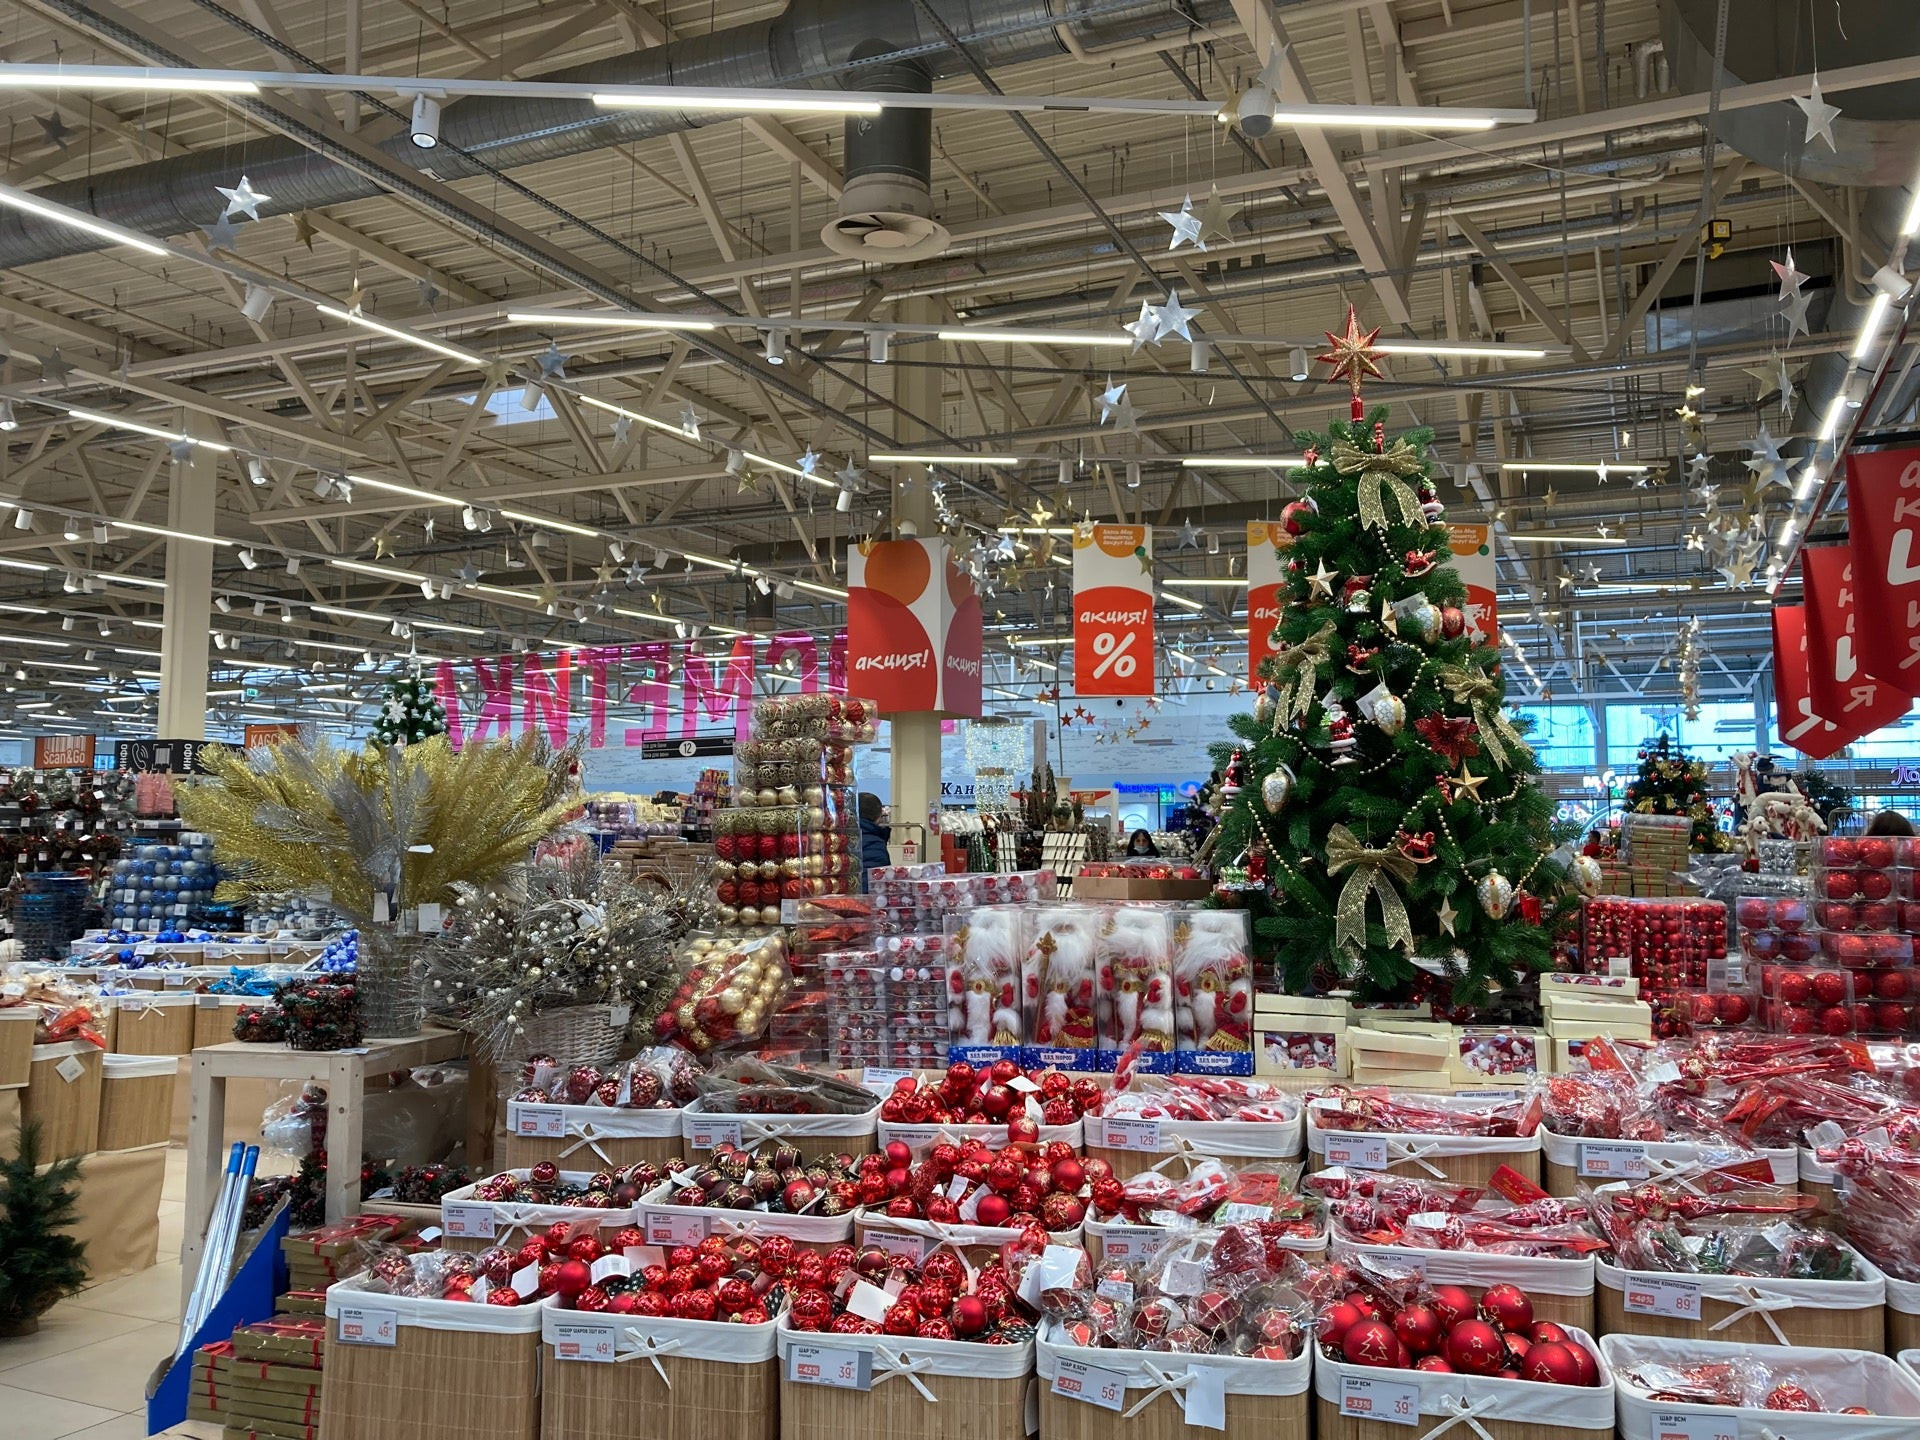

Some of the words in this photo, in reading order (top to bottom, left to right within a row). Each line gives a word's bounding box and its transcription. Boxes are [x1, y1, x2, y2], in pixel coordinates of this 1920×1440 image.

[1080, 609, 1147, 627] акция!
[855, 648, 929, 672] акция!
[946, 655, 980, 677] акция!
[684, 742, 692, 754] 12
[43, 750, 86, 766] Scan&Go
[119, 743, 128, 770] ИНФО
[182, 743, 193, 770] ИНФО
[1161, 791, 1173, 802] 34
[1139, 1135, 1154, 1146] 129
[1365, 1151, 1380, 1162] 119
[1623, 1160, 1641, 1172] 199
[479, 1221, 489, 1232] 24
[687, 1228, 698, 1239] 24
[1141, 1242, 1159, 1254] 249
[1630, 1276, 1660, 1286] УКРАШЕНИЕ
[1661, 1281, 1697, 1291] КОМПОЗИЦИЯ
[1630, 1293, 1655, 1306] -40%
[1676, 1297, 1691, 1311] 89
[378, 1325, 389, 1337] 49
[596, 1342, 608, 1354] 49
[798, 1365, 819, 1375] -42%
[838, 1366, 852, 1379] 39
[1059, 1379, 1081, 1392] -33%
[1101, 1385, 1116, 1401] 59
[1347, 1398, 1372, 1410] -33%
[1394, 1400, 1409, 1415] 39
